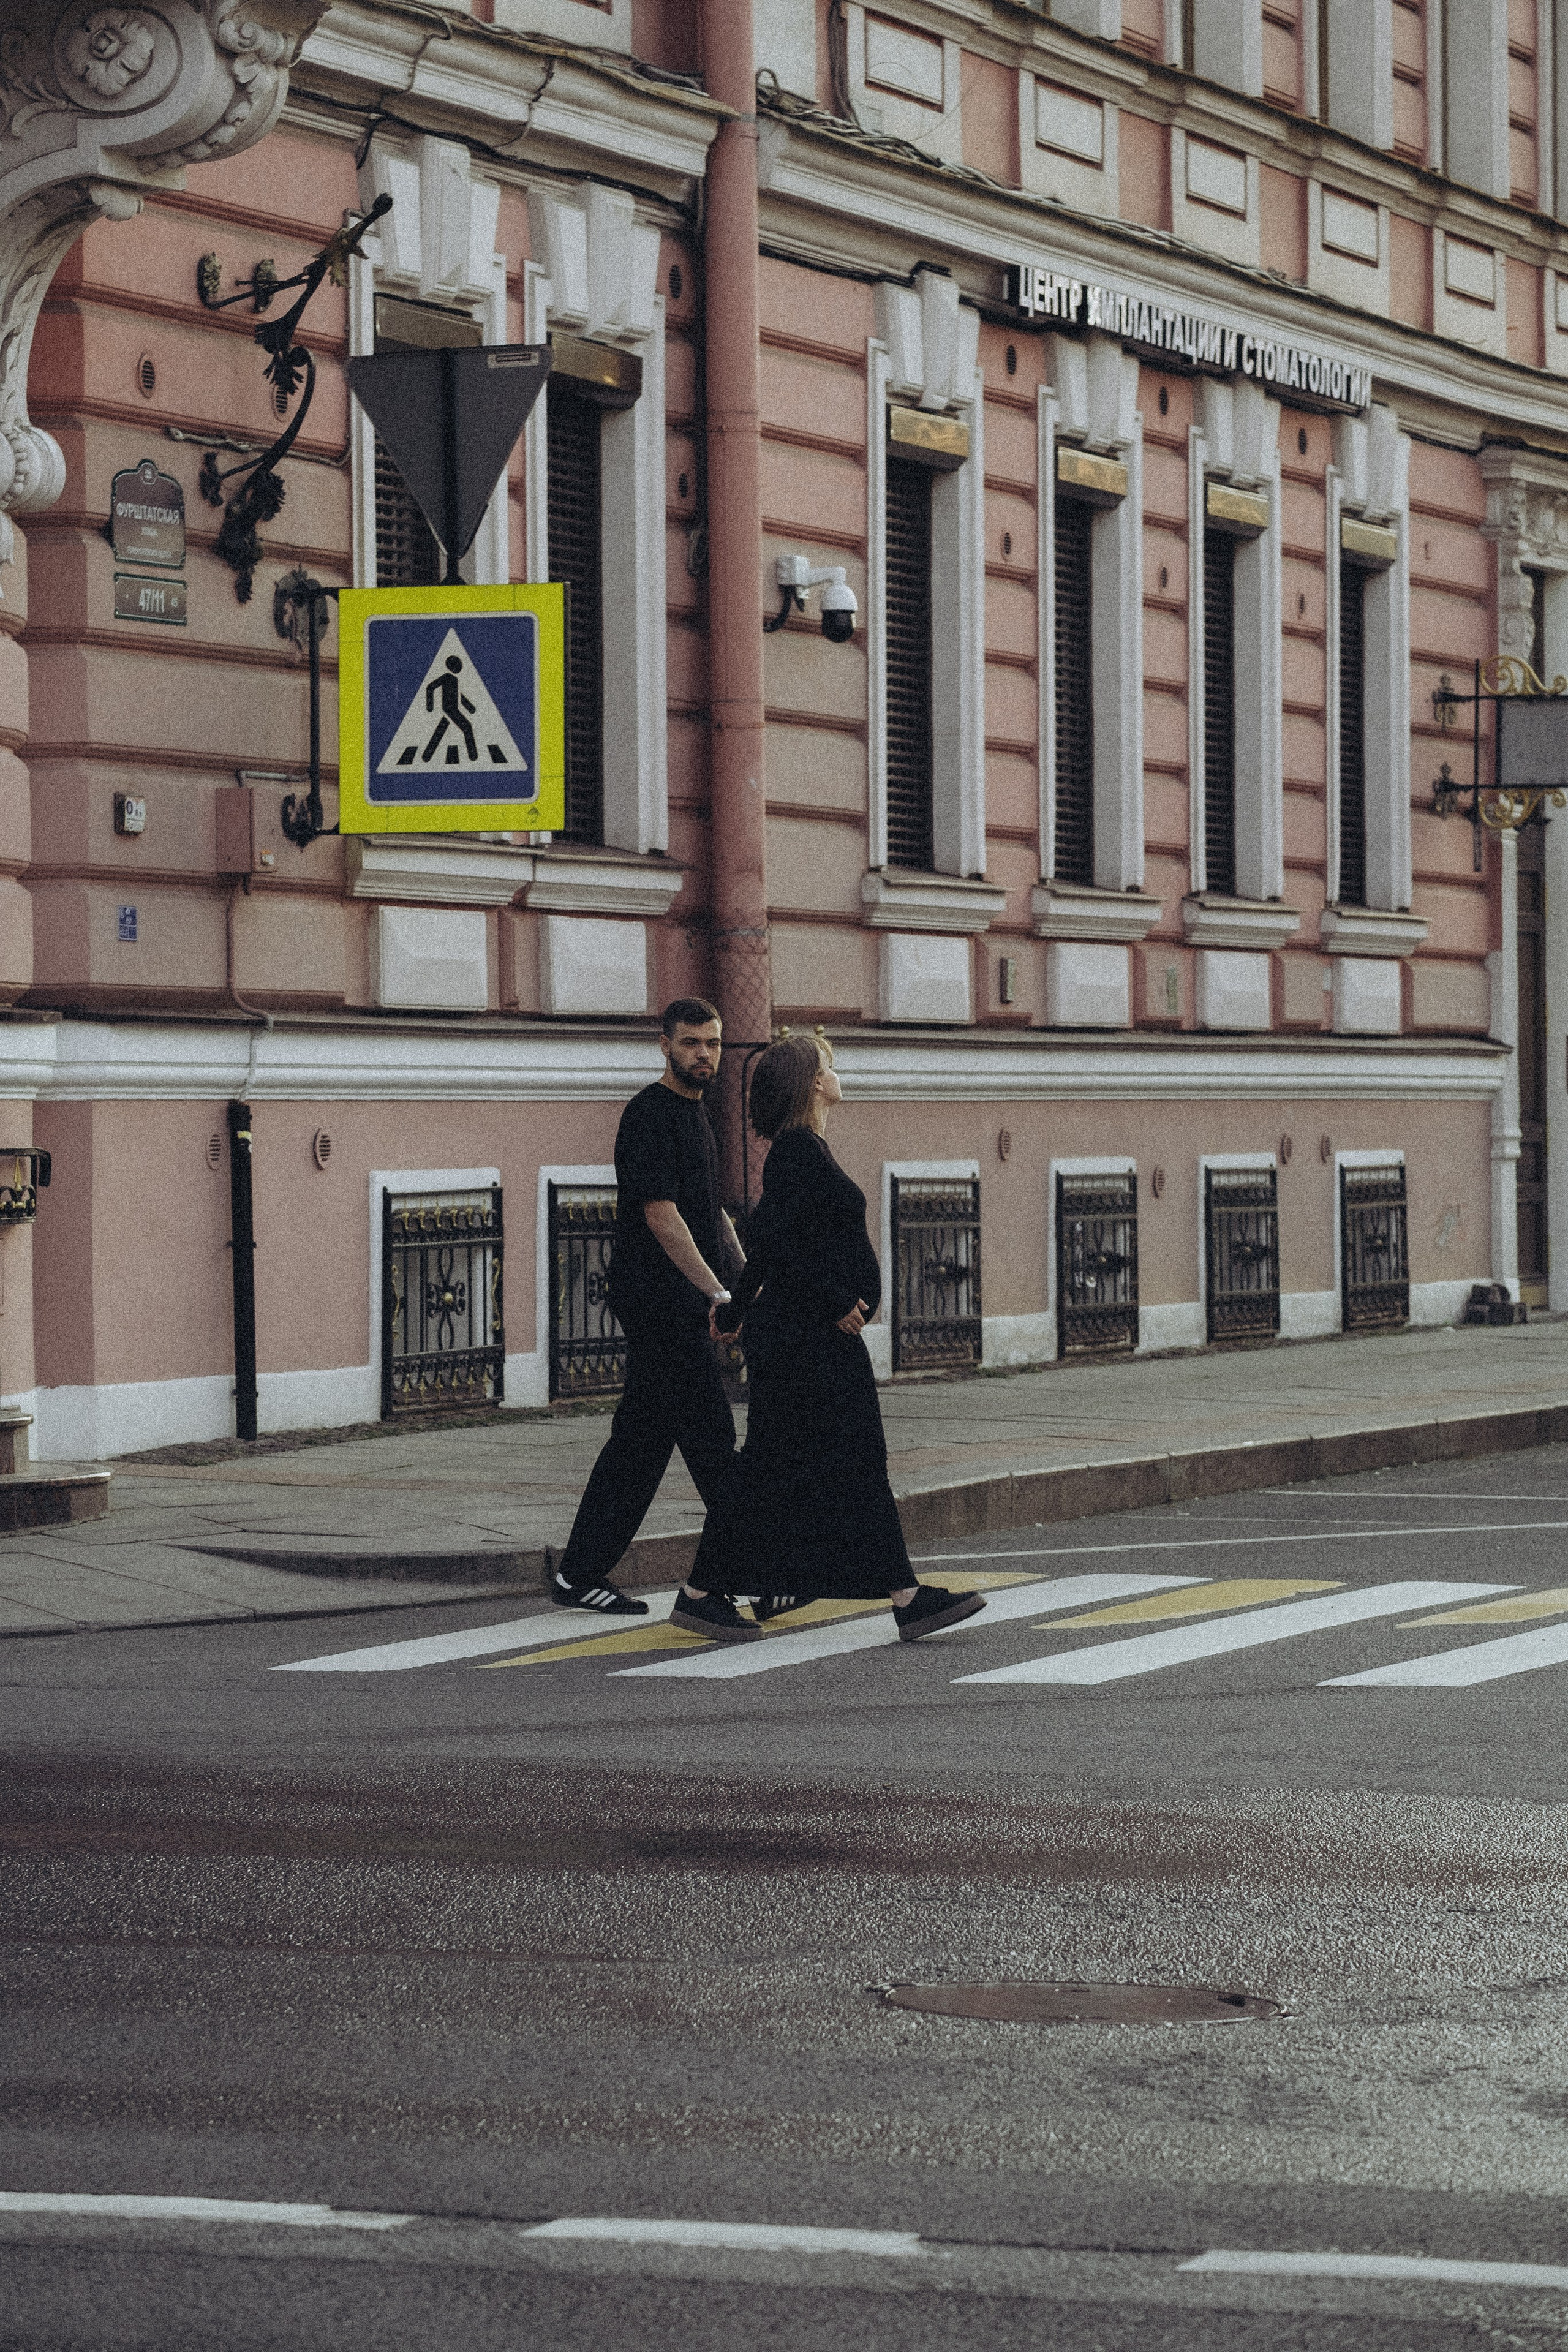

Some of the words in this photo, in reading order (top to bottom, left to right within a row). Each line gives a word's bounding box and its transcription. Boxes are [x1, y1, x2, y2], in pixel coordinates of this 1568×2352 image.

[1019, 265, 1082, 322] ЦЕНТР
[1087, 285, 1221, 364] ИМПЛАНТАЦИИ
[1224, 329, 1238, 370] И
[1242, 336, 1372, 408] СТОМАТОЛОГИИ
[116, 502, 180, 524] ФУРШТАТСКАЯ
[139, 589, 165, 612] 47/11
